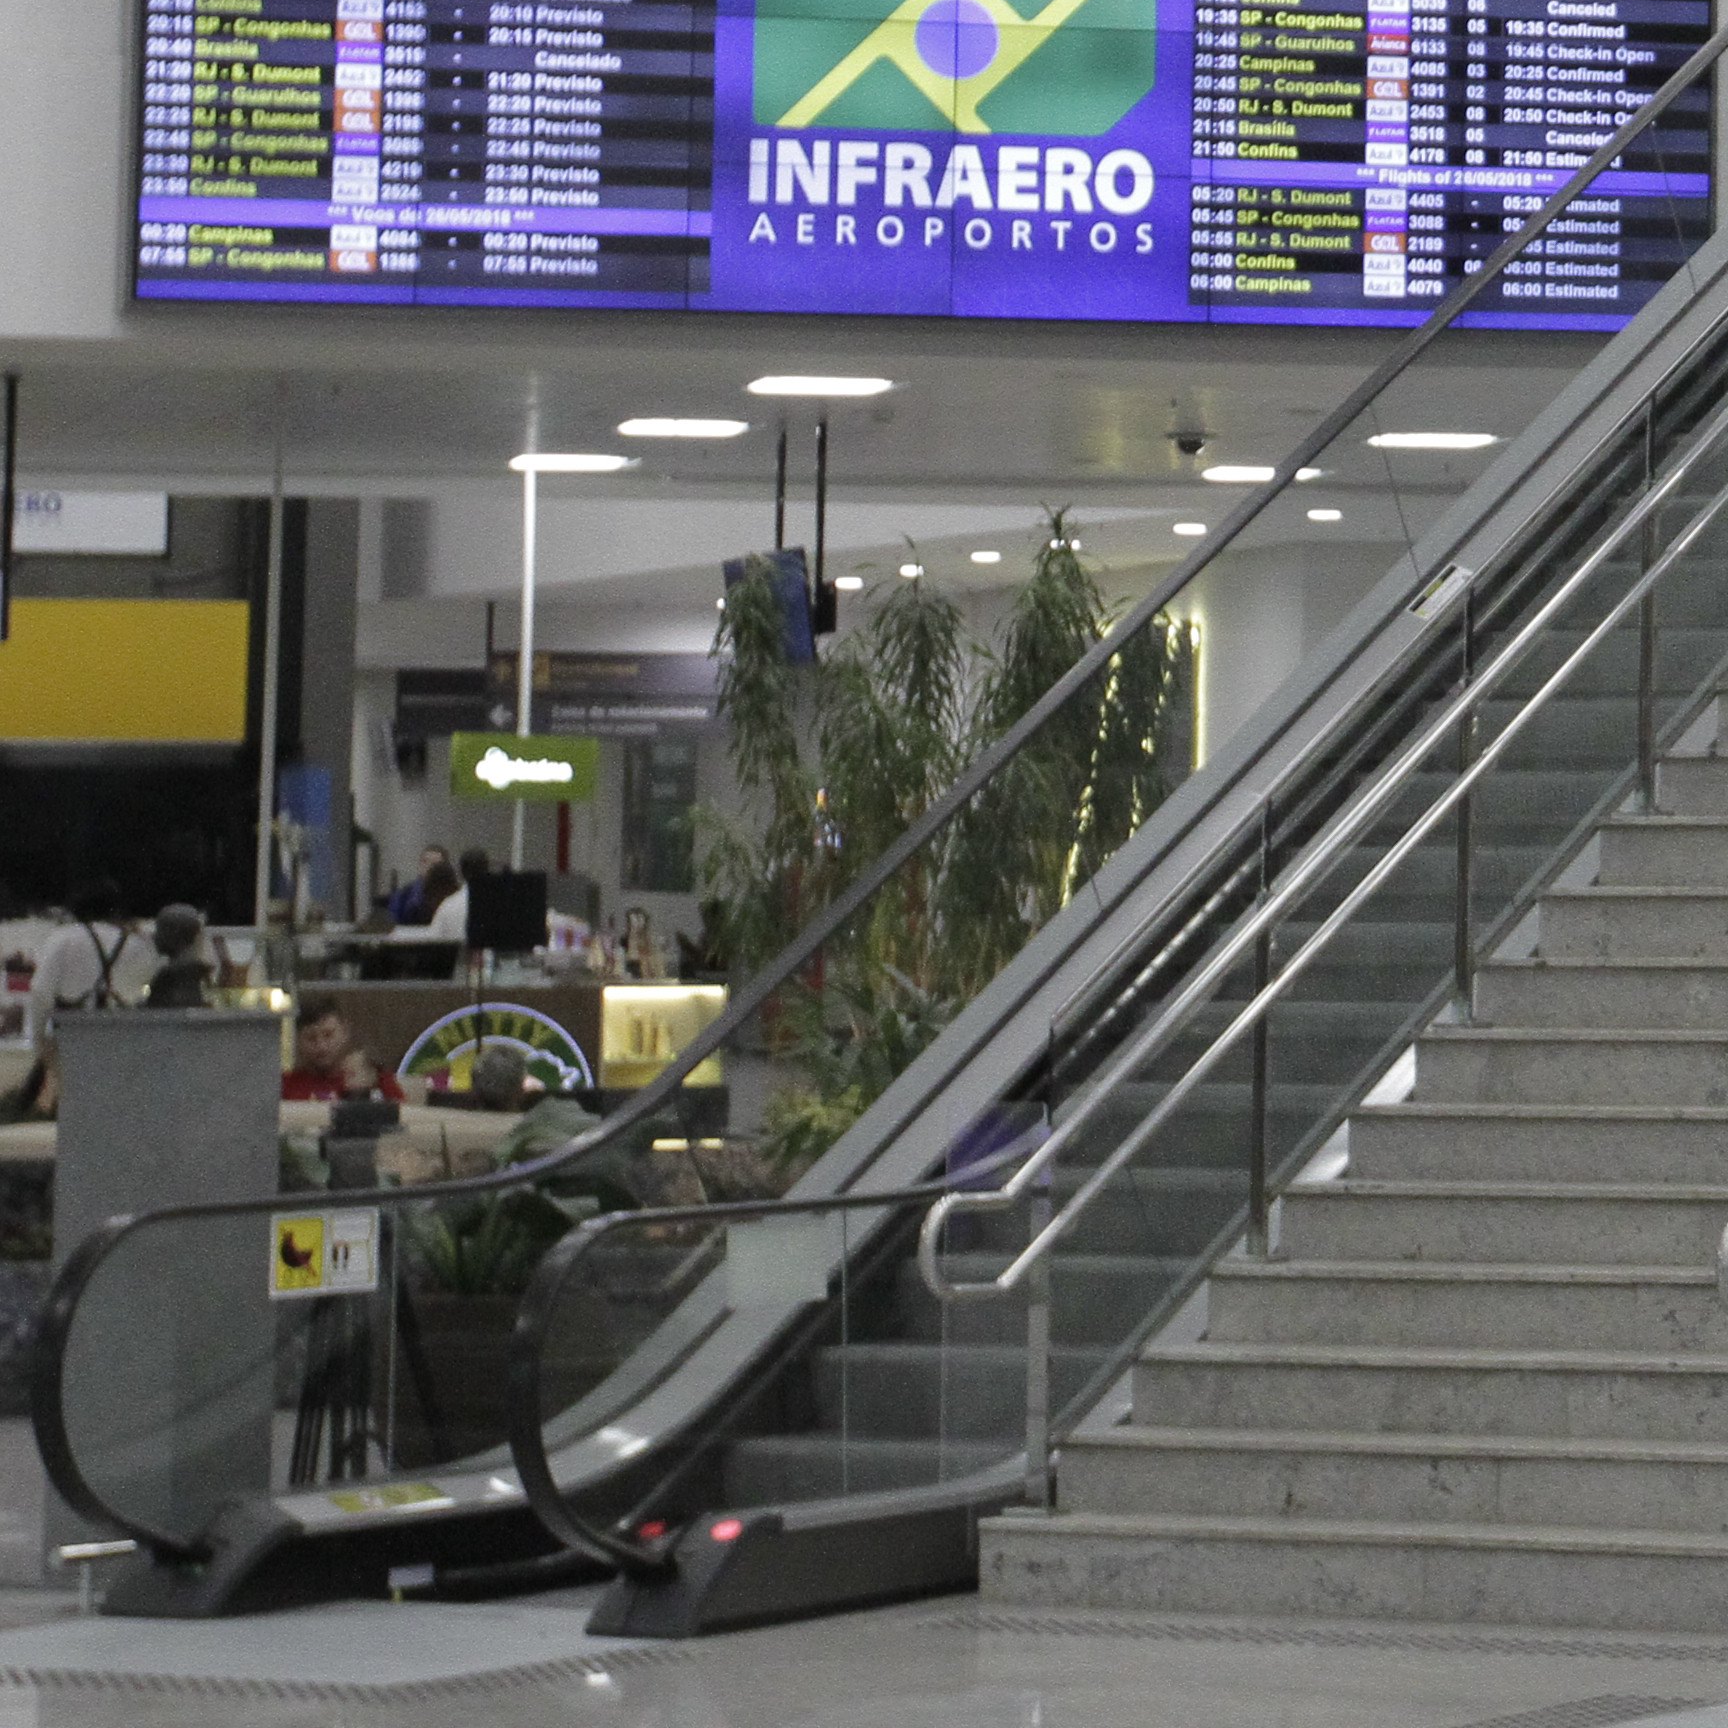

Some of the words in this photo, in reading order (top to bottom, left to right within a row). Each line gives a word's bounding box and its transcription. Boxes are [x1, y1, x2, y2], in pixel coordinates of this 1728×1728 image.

[535, 6, 604, 26] Previsto
[1547, 0, 1617, 17] Canceled
[1196, 9, 1238, 25] 19:35
[1275, 12, 1363, 30] Congonhas
[1505, 20, 1545, 37] 19:35
[1547, 22, 1625, 39] Confirmed
[535, 28, 604, 48] Previsto
[1275, 33, 1356, 51] Guarulhos
[1547, 44, 1612, 61] Check-in
[1615, 46, 1655, 65] Open
[535, 50, 622, 72] Cancelado
[1195, 53, 1237, 69] 20:25
[1240, 56, 1315, 74] Campinas
[1505, 64, 1544, 80] 20:25
[1547, 66, 1624, 83] Confirmed
[534, 73, 603, 93] Previsto
[1194, 75, 1237, 91] 20:45
[1273, 78, 1362, 96] Congonhas
[1411, 82, 1445, 99] 1391
[1504, 86, 1543, 102] 20:45
[1546, 87, 1611, 104] Check-in
[534, 95, 602, 115] Previsto
[1291, 101, 1354, 118] Dumont
[1503, 108, 1543, 124] 20:50
[1546, 109, 1611, 125] Check-in
[534, 118, 602, 139] Previsto
[1238, 120, 1296, 138] Brasília
[533, 140, 601, 161] Previsto
[1237, 142, 1299, 160] Confins
[1503, 150, 1543, 167] 21:50
[532, 165, 600, 185] Previsto
[747, 138, 1155, 216] INFRAERO
[1379, 168, 1431, 186] Flights
[531, 187, 600, 208] Previsto
[1290, 189, 1352, 206] Dumont
[1503, 196, 1542, 211] 05:20
[1271, 210, 1360, 229] Congonhas
[748, 211, 1155, 253] AEROPORTOS
[530, 233, 599, 253] Previsto
[1289, 233, 1351, 249] Dumont
[1545, 240, 1620, 256] Estimated
[530, 255, 598, 276] Previsto
[1235, 254, 1297, 271] Confins
[1407, 258, 1443, 274] 4040
[1545, 262, 1619, 278] Estimated
[1235, 276, 1312, 294] Campinas
[1545, 283, 1619, 299] Estimated
